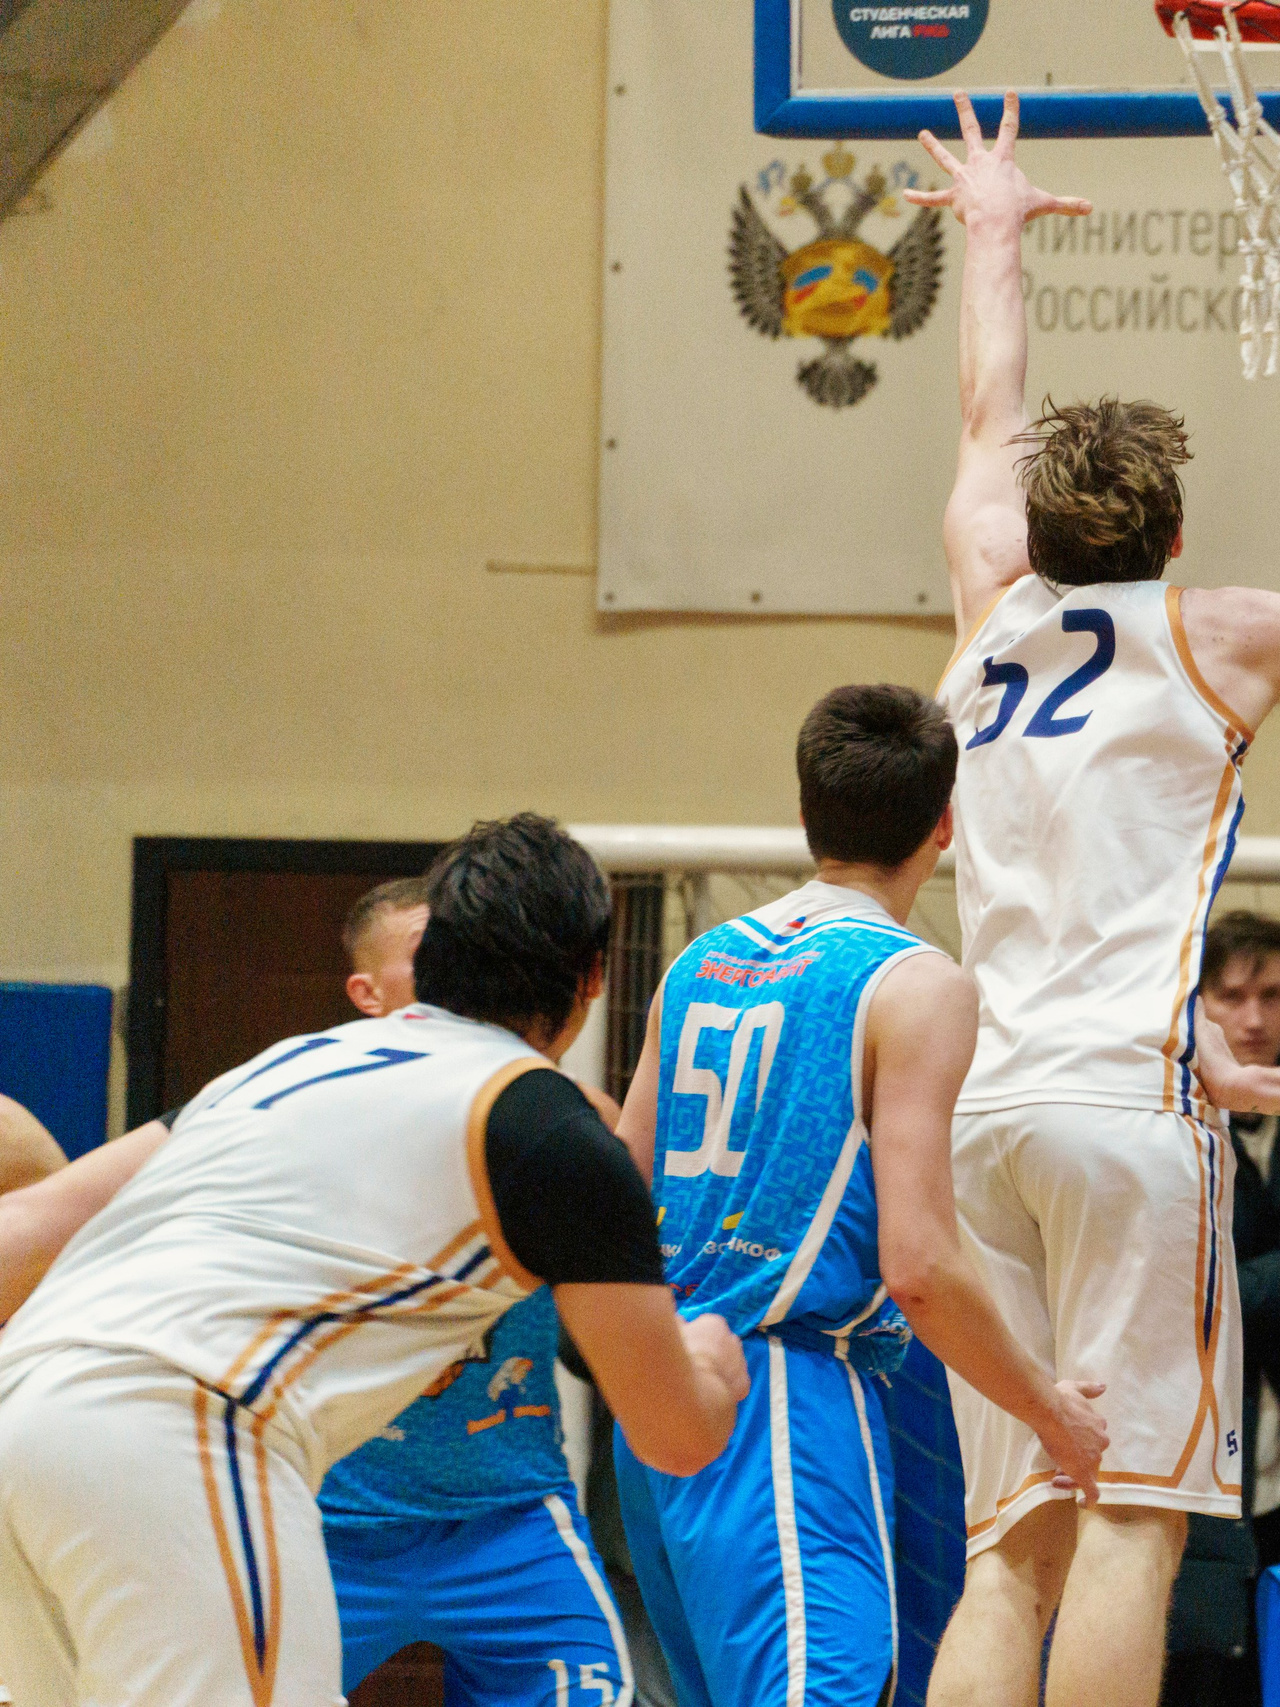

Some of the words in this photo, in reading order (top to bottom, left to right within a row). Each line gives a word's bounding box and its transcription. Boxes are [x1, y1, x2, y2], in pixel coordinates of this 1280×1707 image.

[849, 5, 970, 21] СТУДЕНЧЕСКАЯ
[870, 25, 912, 39] ЛИГА
[1022, 268, 1278, 333] оссийск
[664, 1000, 786, 1178] 50
[547, 1658, 615, 1707] 15
